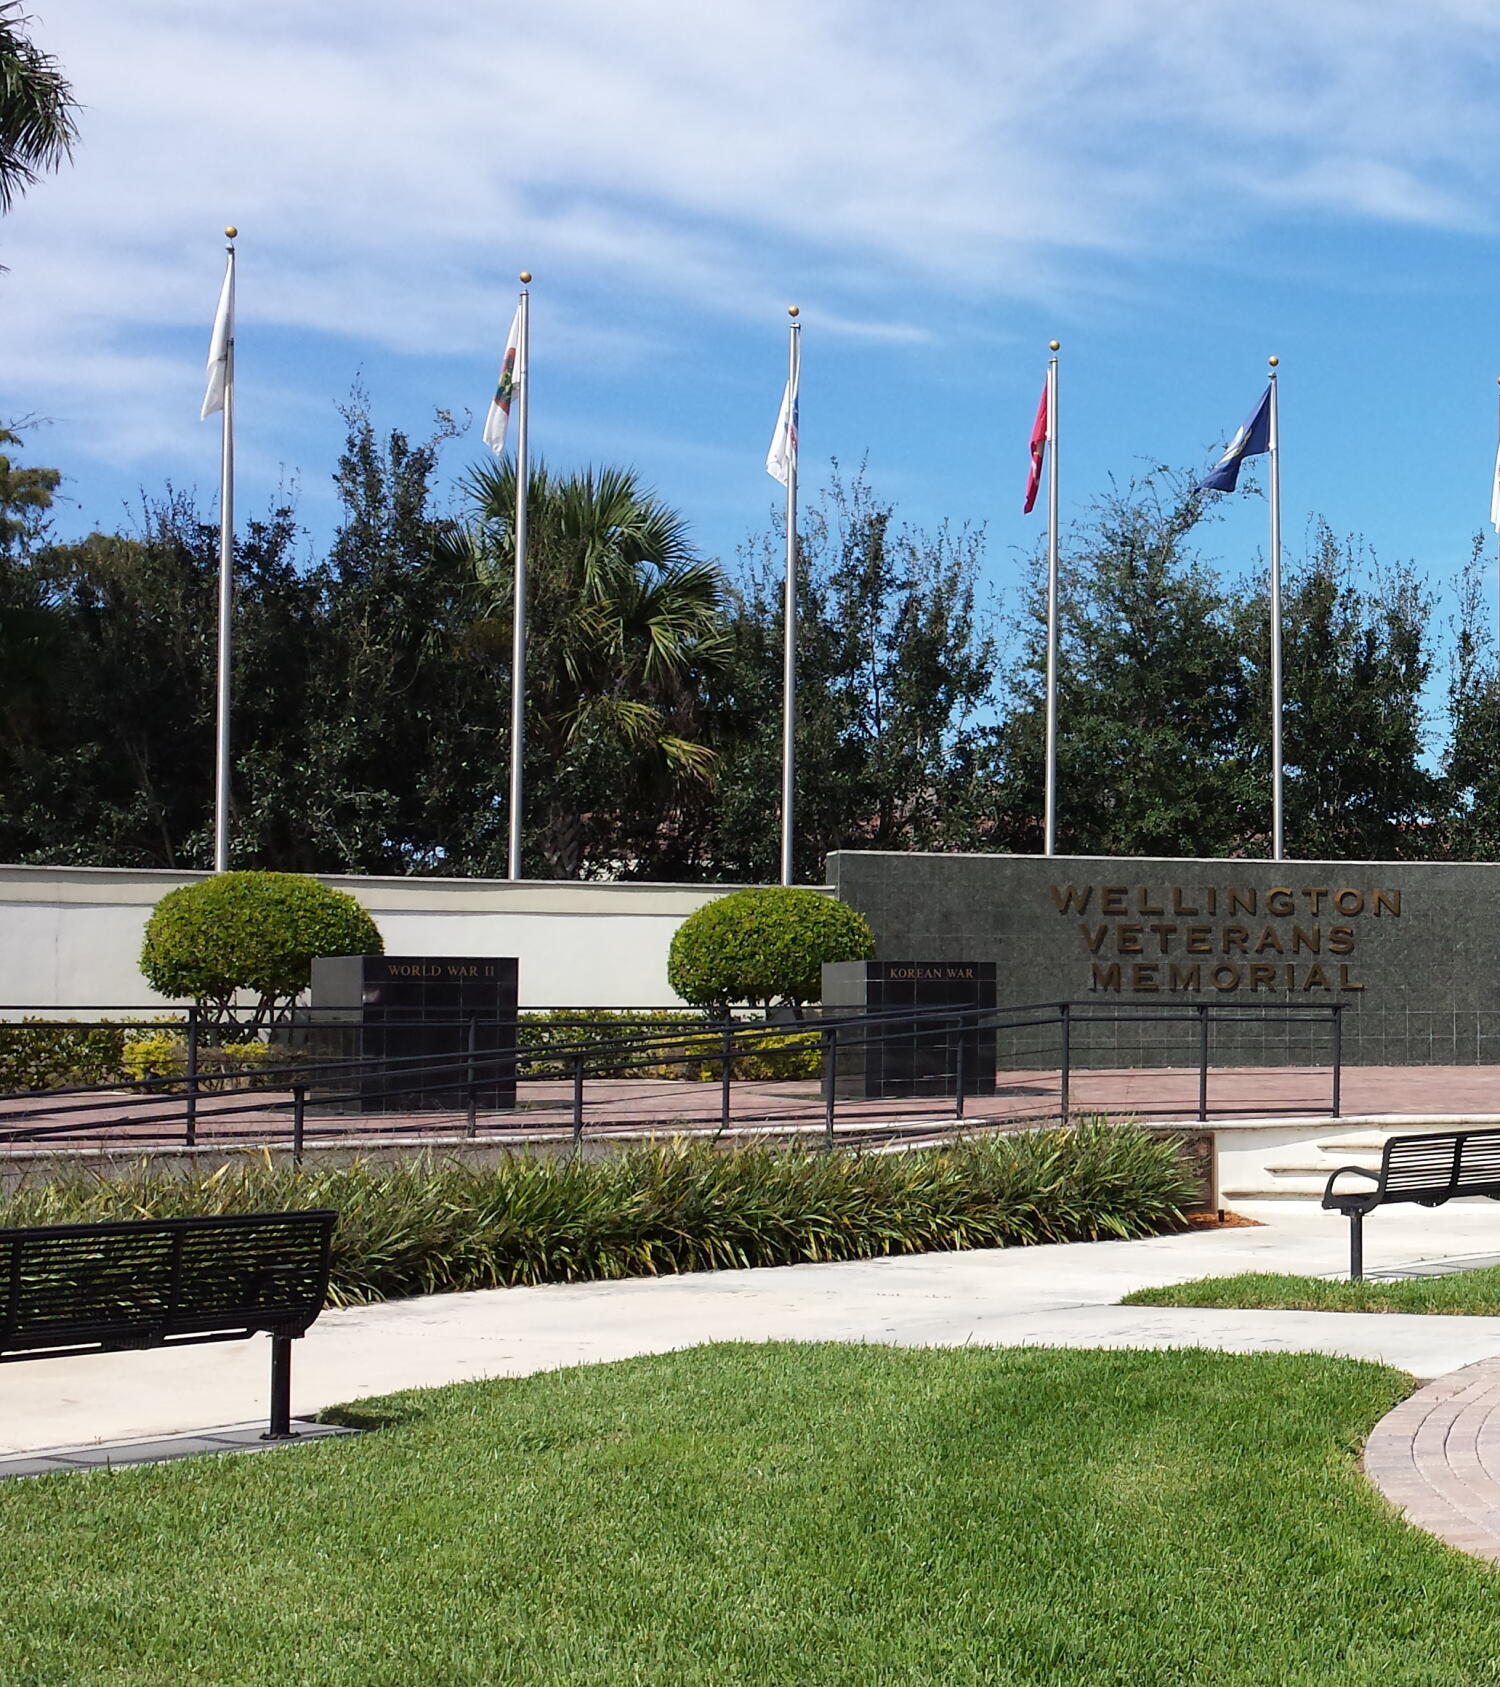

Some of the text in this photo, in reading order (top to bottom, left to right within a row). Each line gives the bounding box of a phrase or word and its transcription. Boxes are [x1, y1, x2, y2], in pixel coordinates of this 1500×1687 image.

[1050, 885, 1402, 917] WELLINGTON
[1080, 923, 1355, 954] VETERANS
[388, 965, 495, 977] WORLD WAR II
[890, 967, 974, 978] KOREAN WAR
[1090, 961, 1365, 992] MEMORIAL
